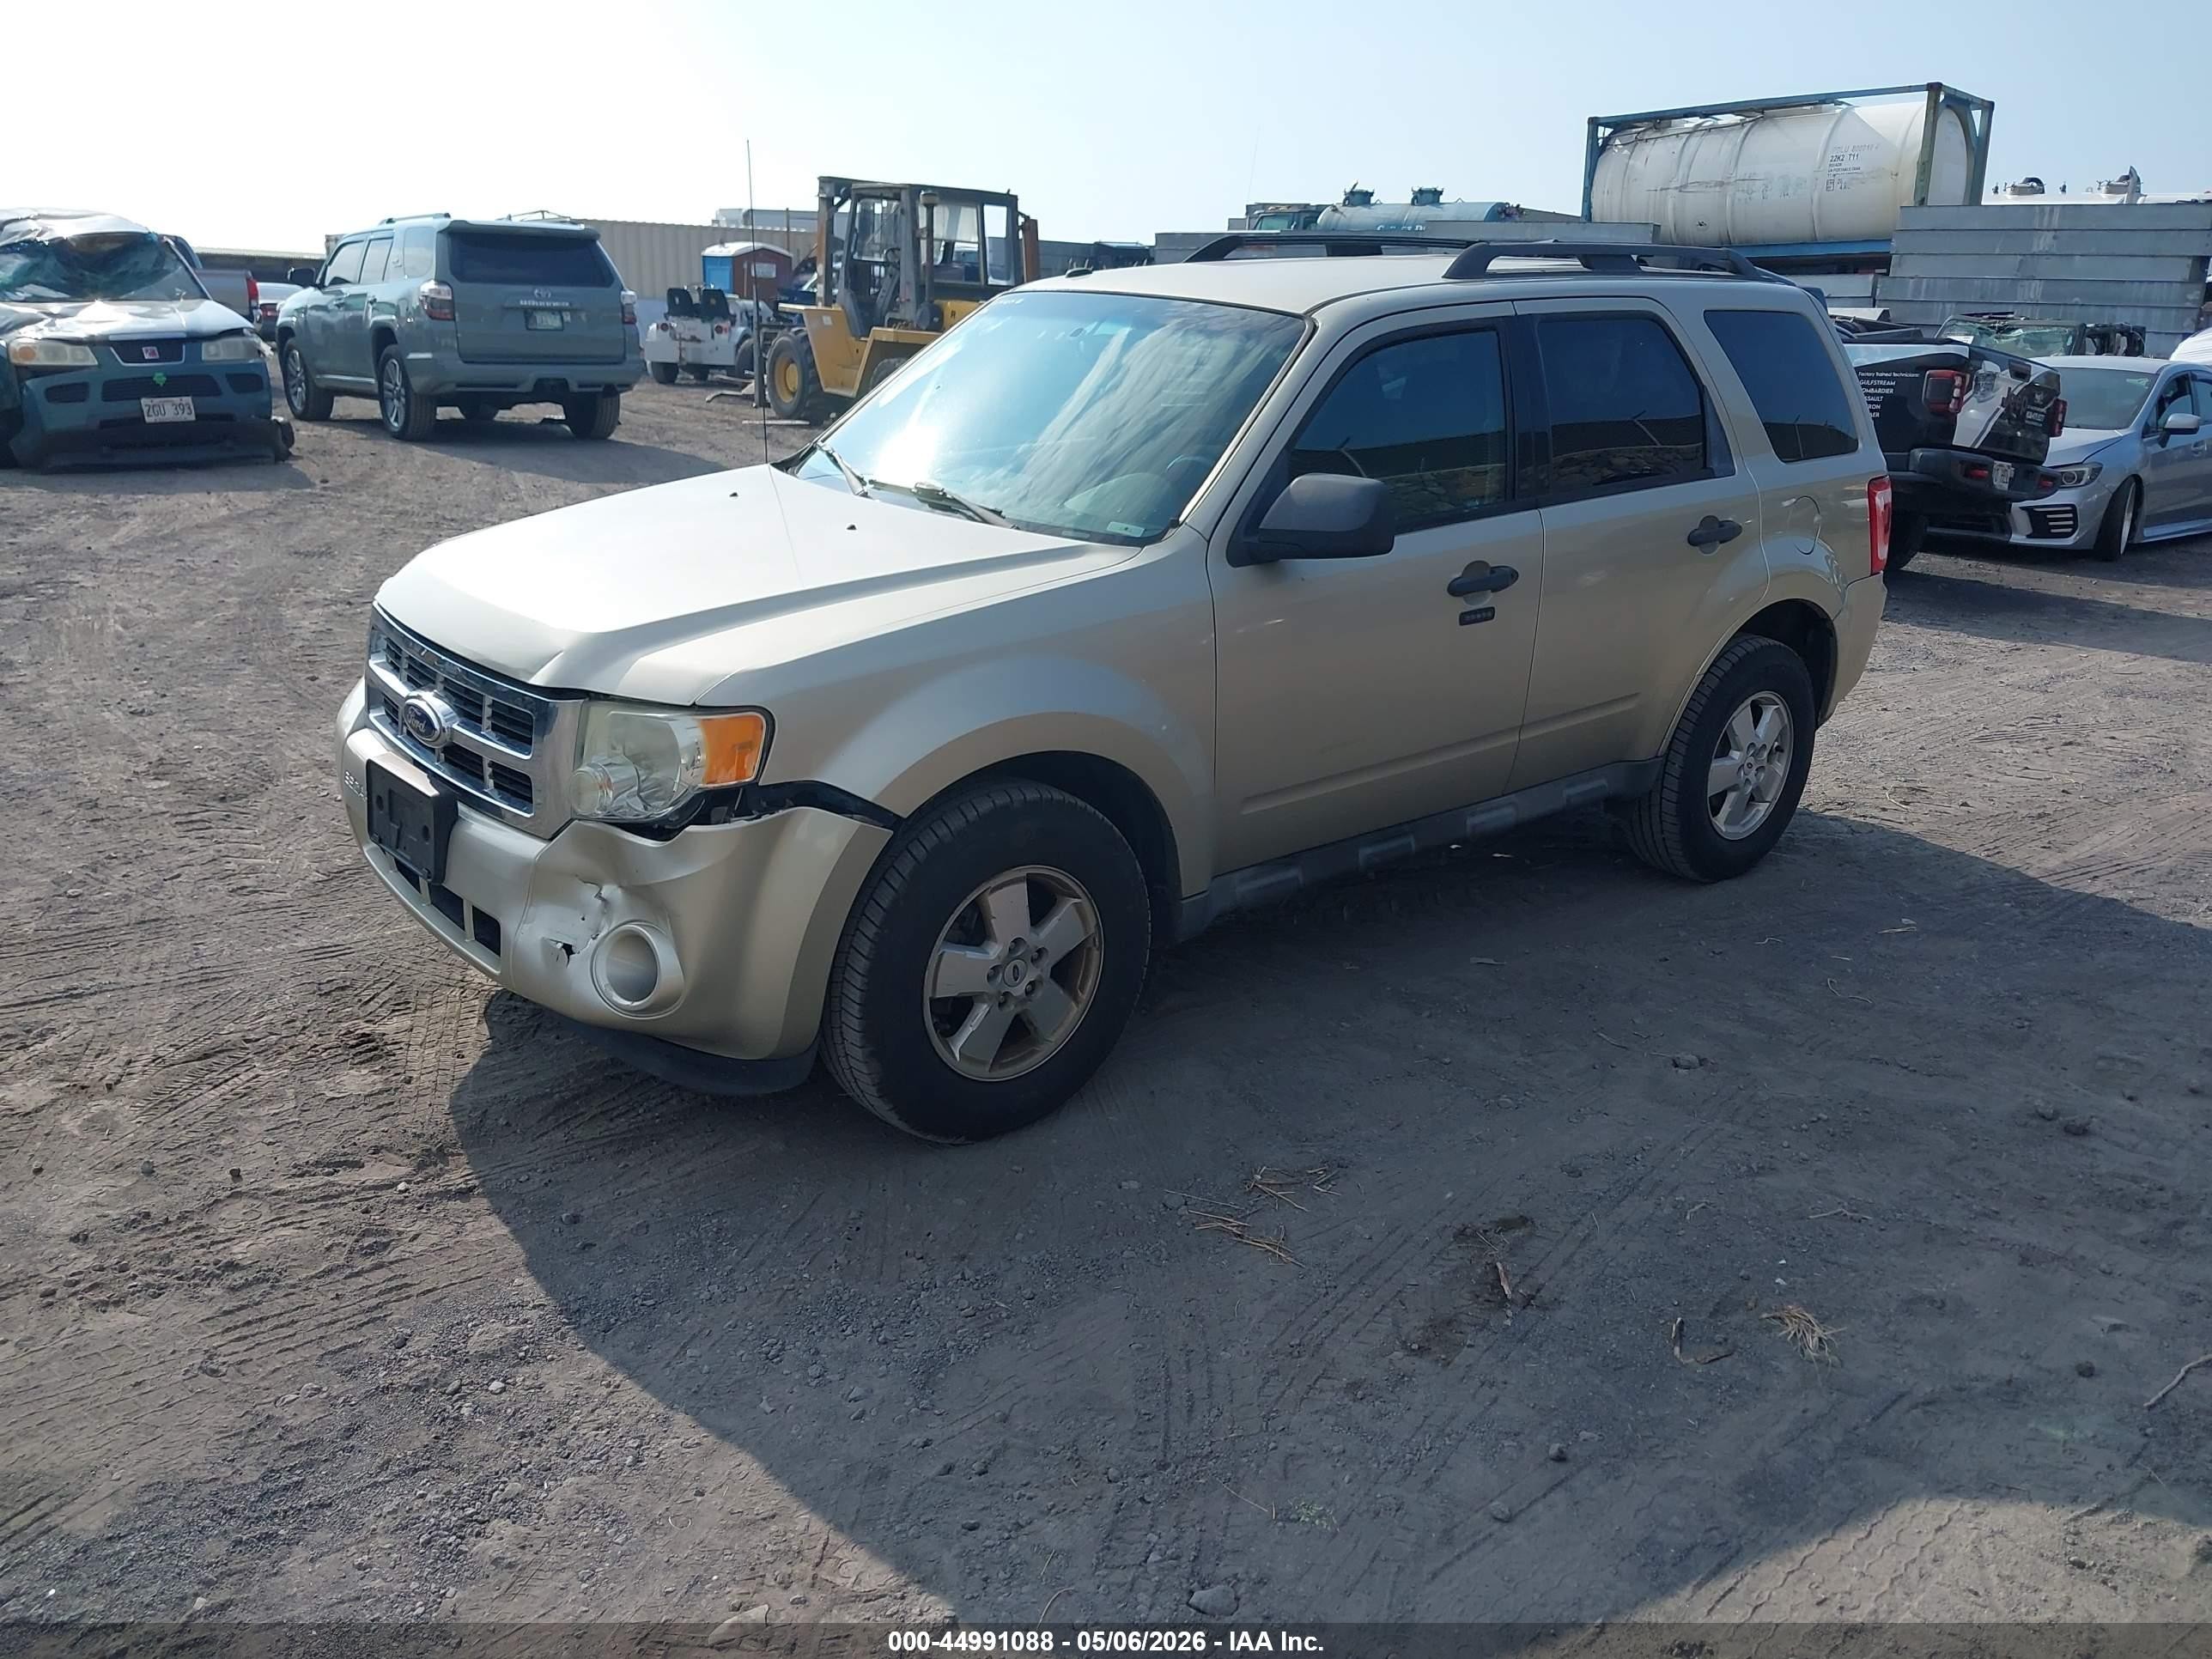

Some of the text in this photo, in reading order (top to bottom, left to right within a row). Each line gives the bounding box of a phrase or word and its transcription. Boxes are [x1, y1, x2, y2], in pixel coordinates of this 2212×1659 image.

[1830, 154, 1844, 162] 22K2
[144, 402, 193, 417] ZGU 393
[406, 706, 427, 733] Ford
